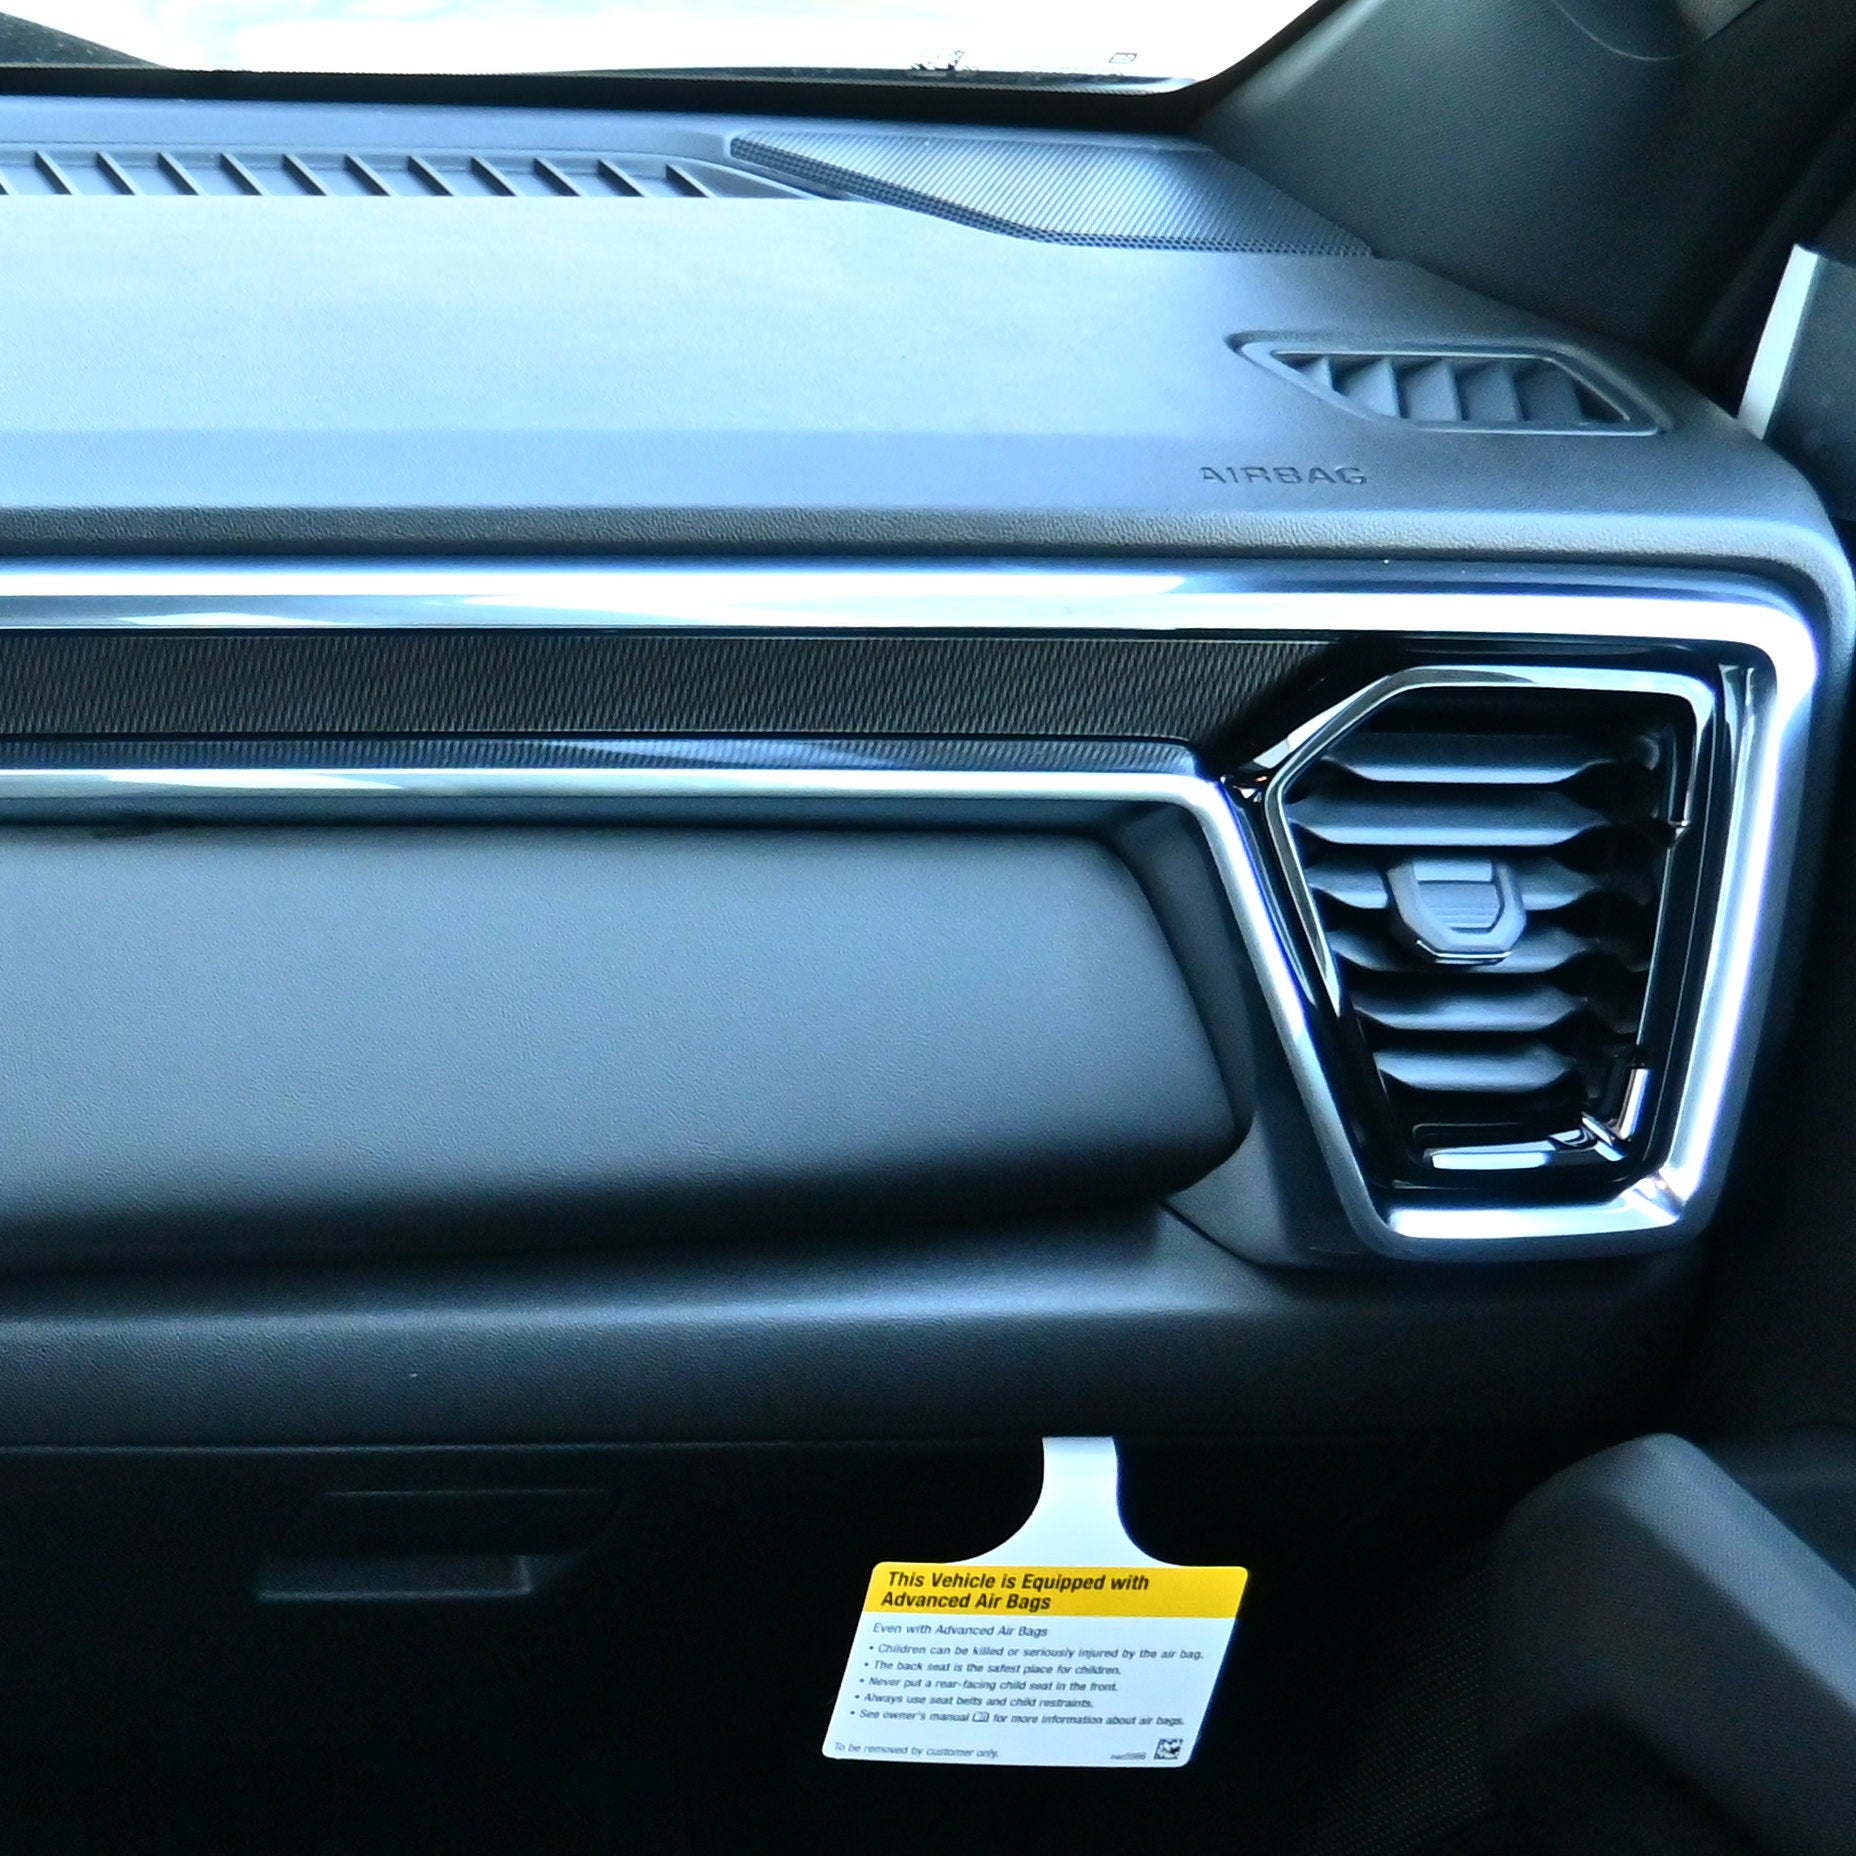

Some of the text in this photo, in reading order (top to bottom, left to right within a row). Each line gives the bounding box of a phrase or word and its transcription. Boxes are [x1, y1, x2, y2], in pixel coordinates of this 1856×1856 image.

[1201, 464, 1368, 487] AIRBAG
[888, 1571, 1149, 1593] This Vehicle is Equipped with
[880, 1592, 1051, 1613] Advanced Air Bags
[873, 1622, 1048, 1638] Even with Advanced Air Bags
[878, 1644, 926, 1655] Children
[930, 1647, 951, 1655] can
[954, 1646, 969, 1656] be
[972, 1646, 1004, 1656] killed
[1023, 1648, 1075, 1659] seriously
[1078, 1648, 1119, 1660] injured
[1122, 1649, 1136, 1660] by
[1139, 1649, 1157, 1659] the
[1161, 1650, 1176, 1659] air
[1180, 1650, 1204, 1660] bag.
[874, 1660, 1122, 1675] The back seat is the safest place for children.
[868, 1677, 900, 1687] Never
[903, 1679, 923, 1689] put
[935, 1680, 996, 1691] rear-facing
[999, 1681, 1026, 1690] child
[1029, 1682, 1052, 1691] seat
[1056, 1682, 1066, 1691] in
[1069, 1682, 1087, 1691] the
[1090, 1682, 1118, 1692] front.
[864, 1693, 1094, 1708] Always use seat belts and child restraints.
[859, 1709, 880, 1719] See
[882, 1711, 926, 1720] owner's
[929, 1712, 969, 1721] manual
[993, 1714, 1008, 1723] for
[1041, 1715, 1103, 1725] information
[1105, 1716, 1136, 1725] about
[1138, 1717, 1153, 1725] air
[1155, 1717, 1184, 1727] bags.
[834, 1742, 845, 1751] To
[847, 1743, 861, 1752] be
[864, 1745, 908, 1754] removed
[911, 1747, 922, 1756] by
[926, 1747, 974, 1757] customer
